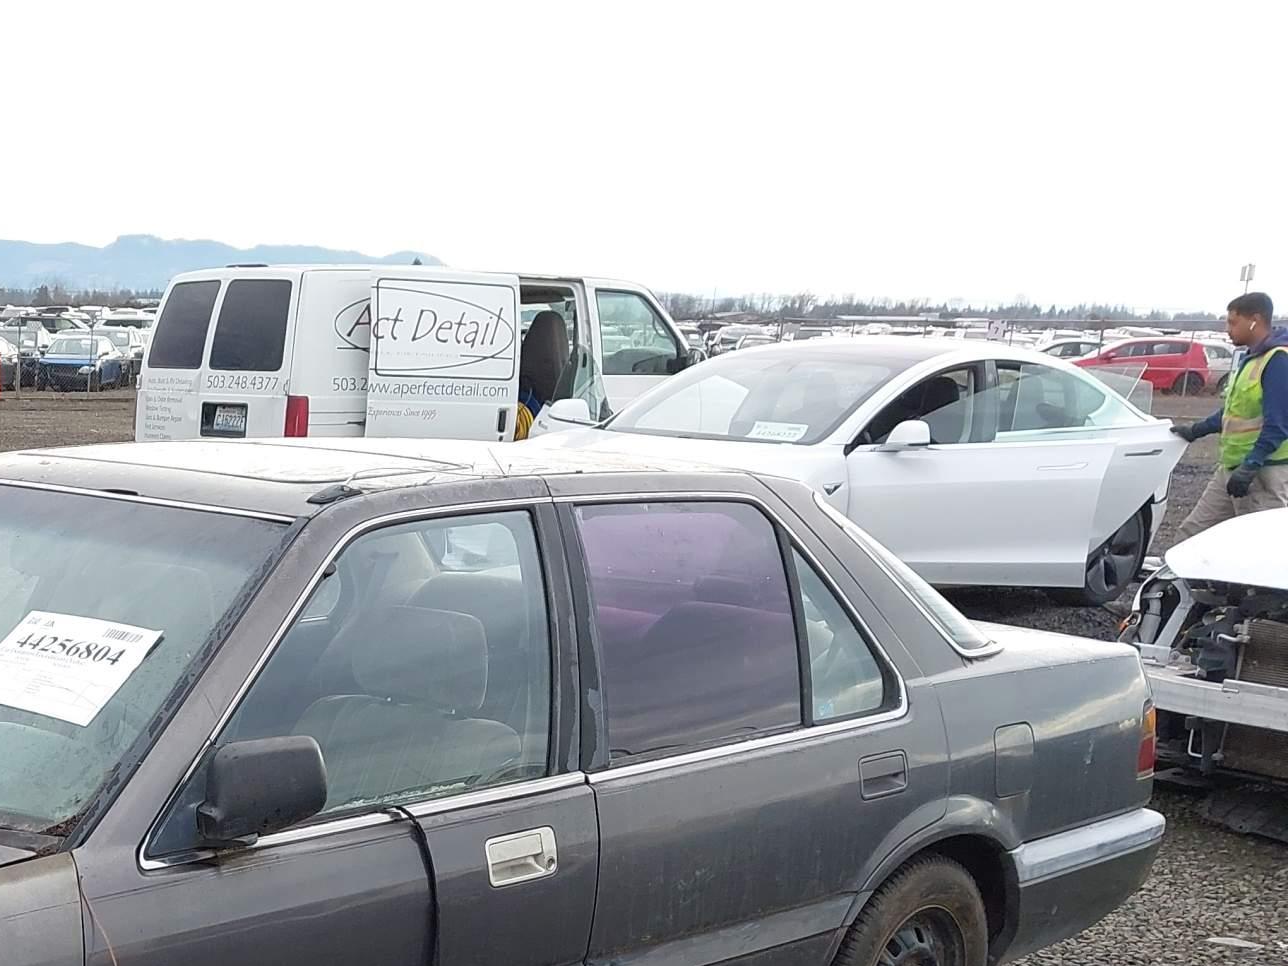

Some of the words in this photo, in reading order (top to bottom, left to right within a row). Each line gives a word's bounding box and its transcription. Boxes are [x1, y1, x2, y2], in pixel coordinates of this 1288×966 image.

[411, 307, 504, 349] Detail
[207, 375, 279, 391] 503.248.4377
[332, 377, 368, 392] 503.2
[16, 633, 125, 665] 44256804
